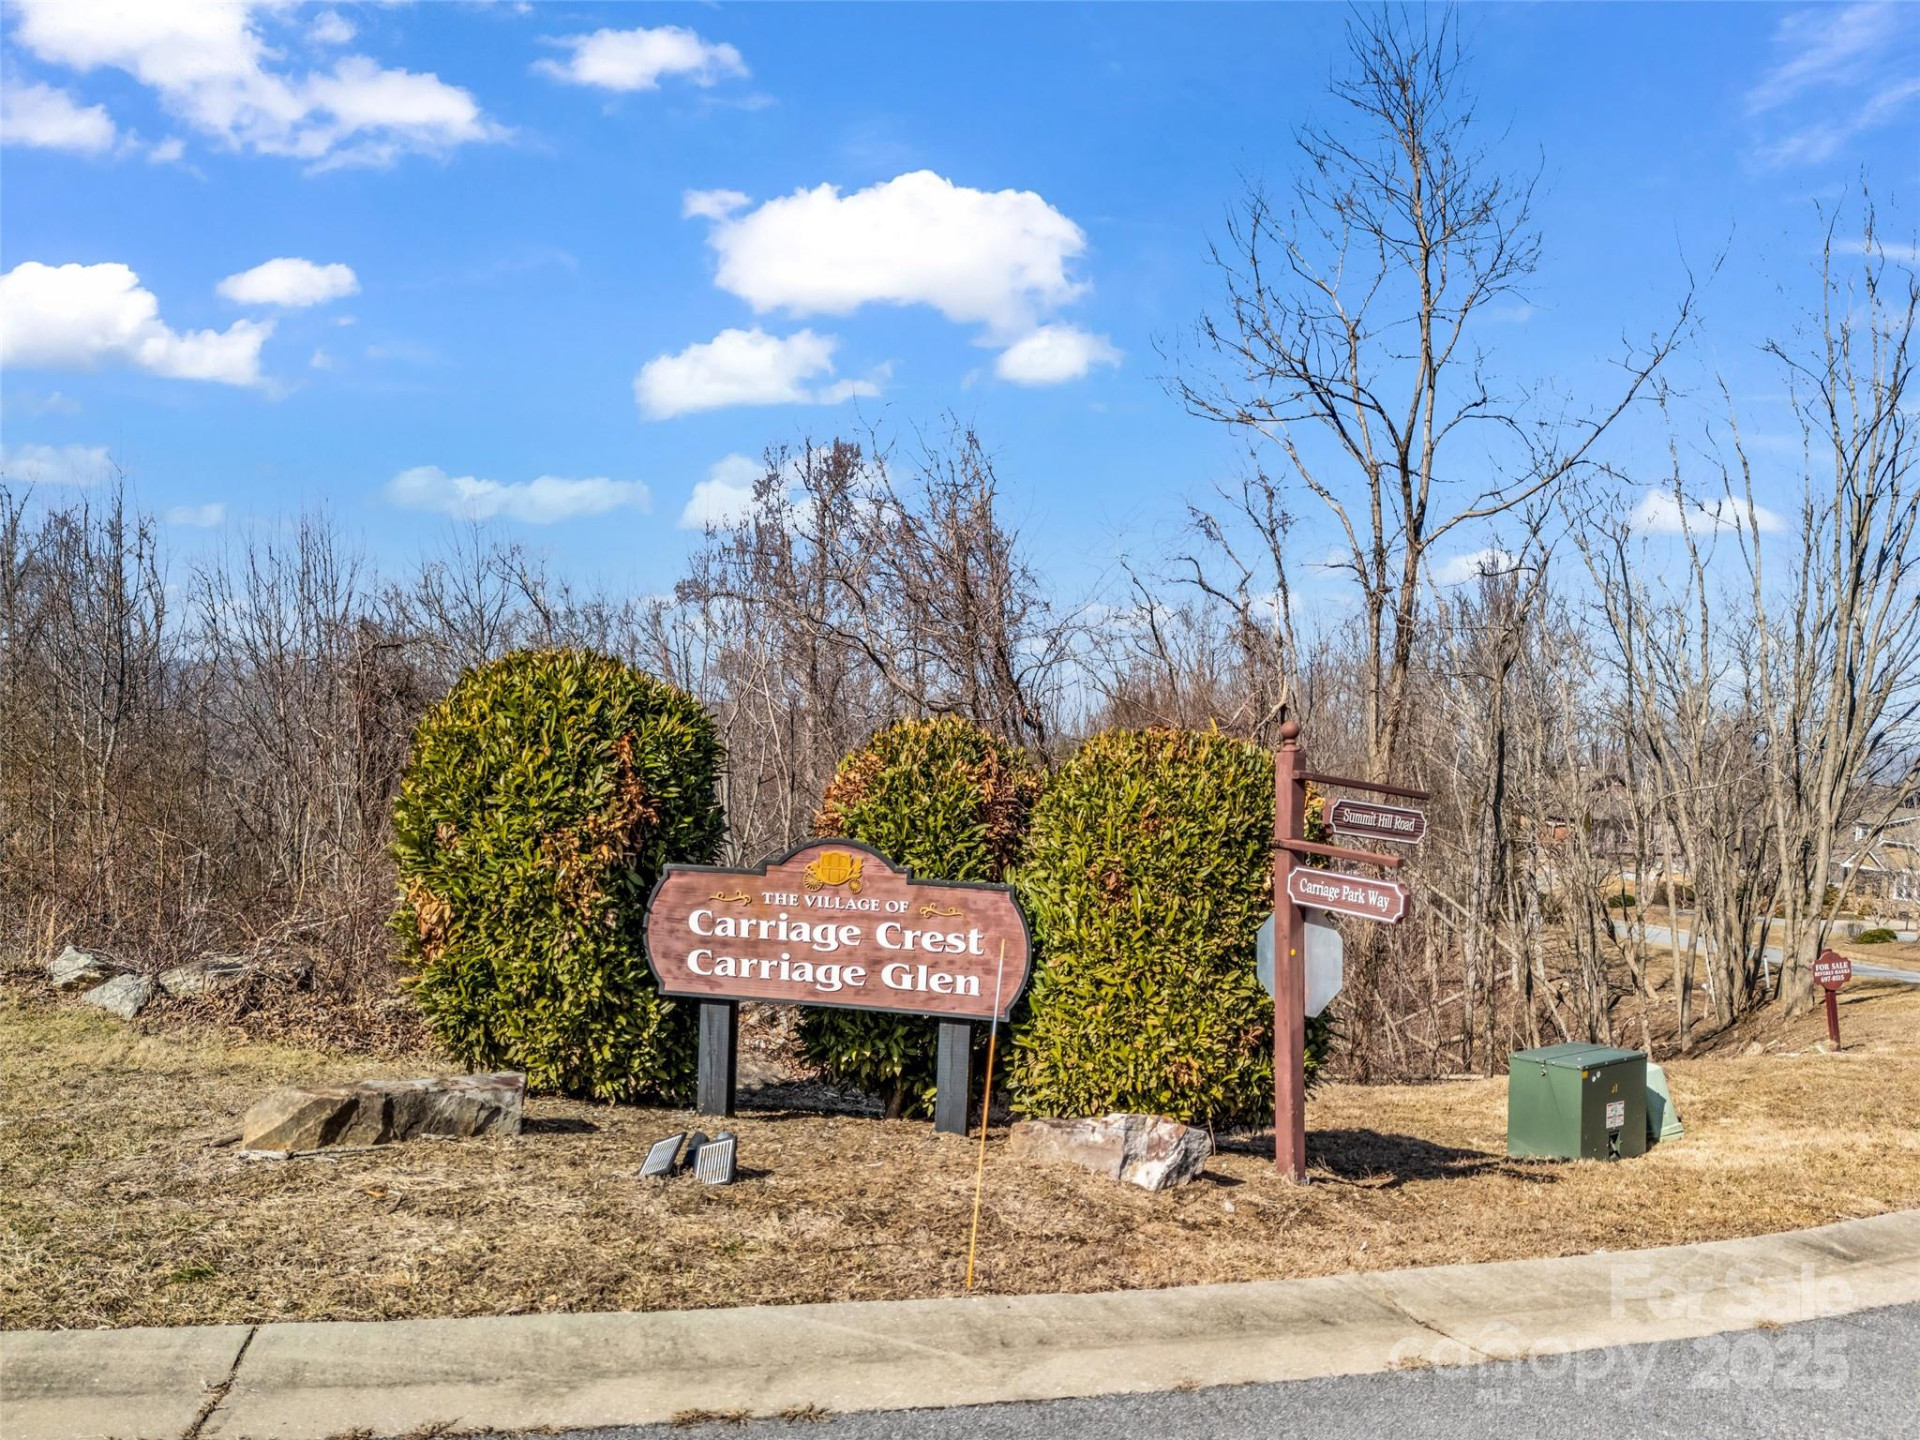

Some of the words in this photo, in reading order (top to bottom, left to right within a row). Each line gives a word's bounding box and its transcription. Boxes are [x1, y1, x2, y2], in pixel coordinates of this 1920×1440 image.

[1343, 808, 1377, 826] Summit
[1378, 813, 1393, 829] Hill
[1394, 817, 1415, 832] Road
[761, 892, 799, 906] THE
[804, 895, 880, 912] VILLAGE
[885, 900, 910, 914] OF
[1299, 877, 1340, 902] Carriage
[1342, 885, 1365, 904] Park
[1368, 890, 1390, 911] Way
[688, 909, 862, 952] Carriage
[875, 922, 985, 956] Crest
[686, 949, 868, 992] Carriage
[881, 962, 981, 997] Glen
[1815, 963, 1830, 972] FOR
[1832, 962, 1848, 970] SALE
